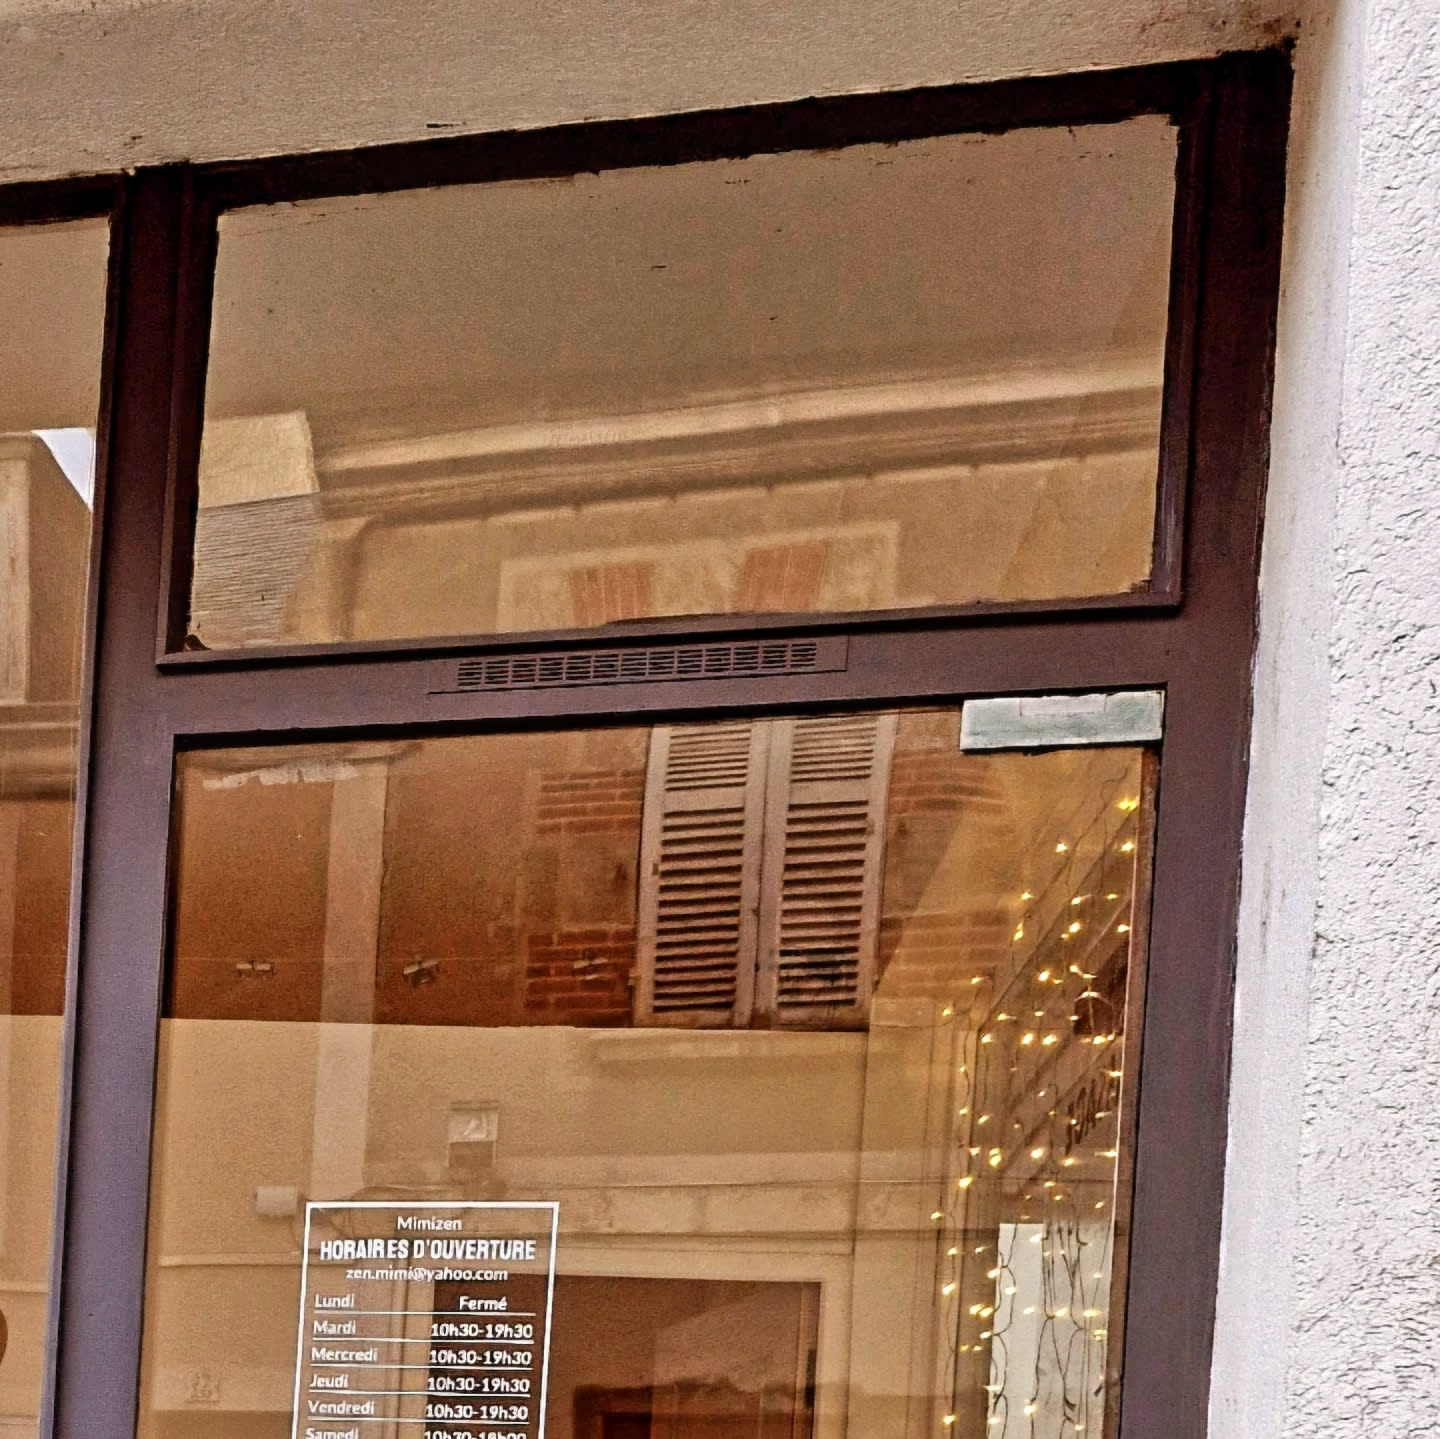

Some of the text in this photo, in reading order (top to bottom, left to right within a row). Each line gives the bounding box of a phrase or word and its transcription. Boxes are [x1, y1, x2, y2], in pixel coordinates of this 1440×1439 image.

[396, 1216, 463, 1232] Mimizen
[319, 1239, 536, 1260] HORAIRES D'OUVERTURE
[345, 1266, 509, 1282] zen.mimi@yahoo.com
[314, 1293, 508, 1311] Lundi Fermé
[312, 1320, 534, 1339] Mardi 10h30-19h30
[311, 1347, 532, 1366] Mercredi 10h30-19h30
[309, 1373, 530, 1392] Jeudi 10h30-19h30
[307, 1400, 528, 1420] Vendredi 10h30-19h30
